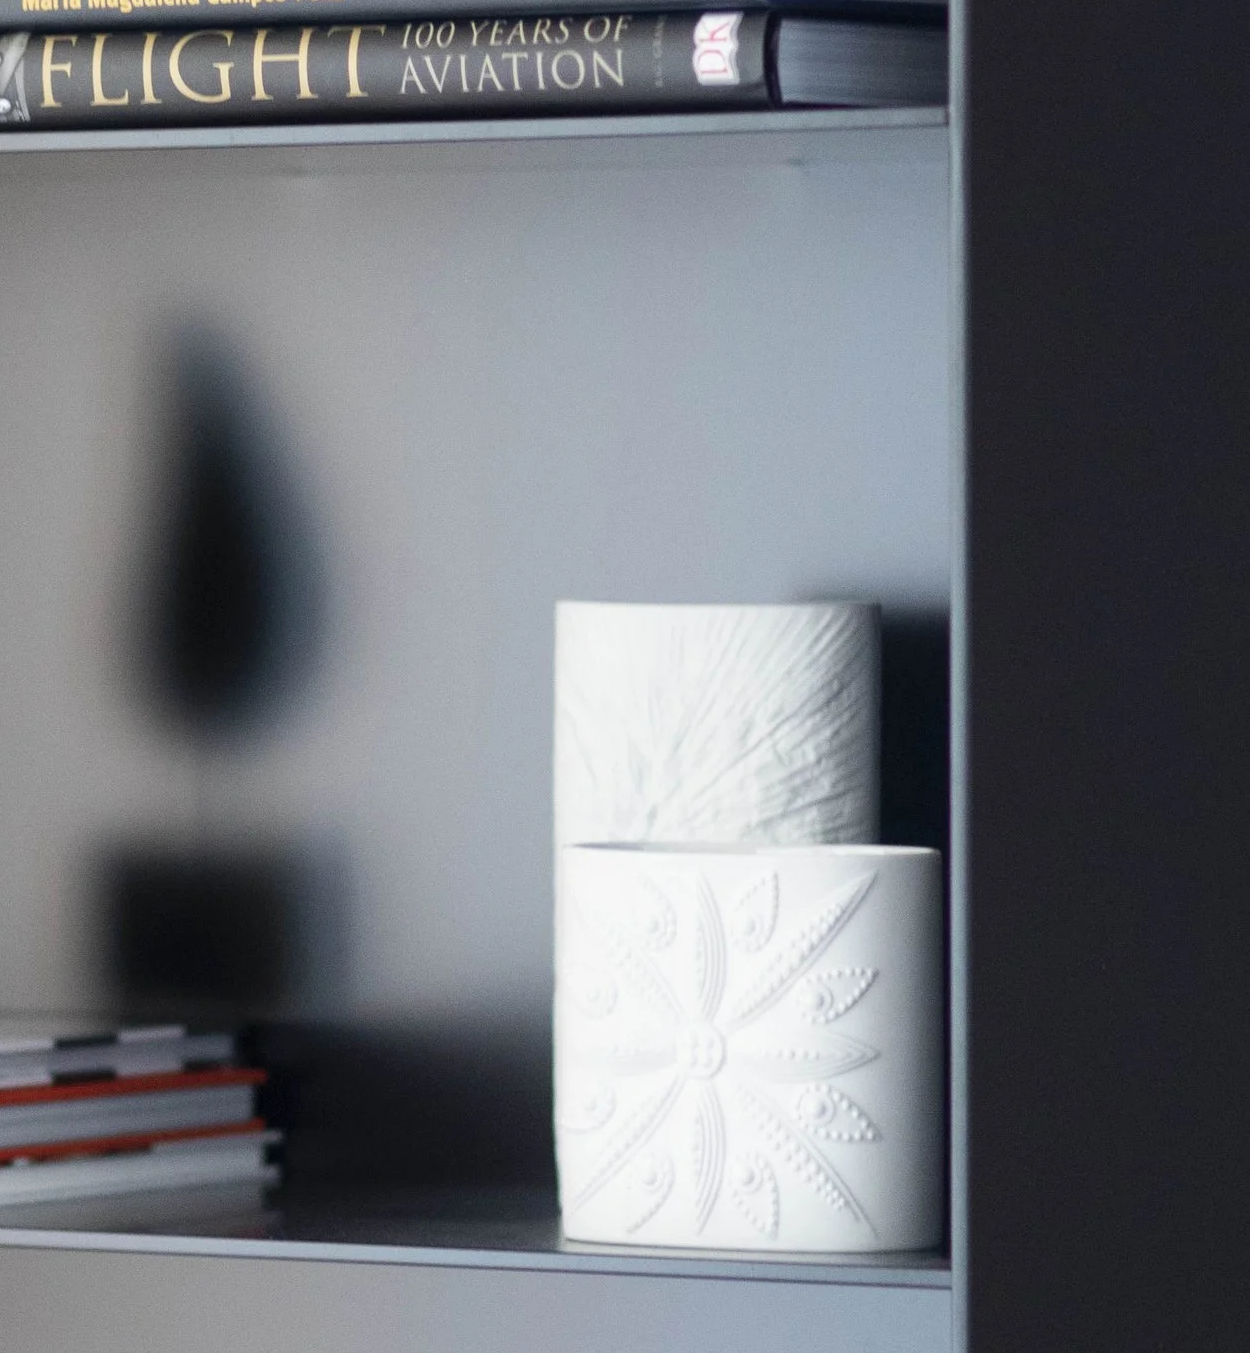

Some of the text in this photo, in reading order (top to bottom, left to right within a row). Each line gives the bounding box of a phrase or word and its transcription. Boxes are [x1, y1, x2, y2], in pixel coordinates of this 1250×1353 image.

[402, 15, 632, 49] 100 YEARS OF
[698, 21, 730, 75] DK
[40, 25, 387, 108] FLIGHT
[400, 49, 625, 94] AVIATION
